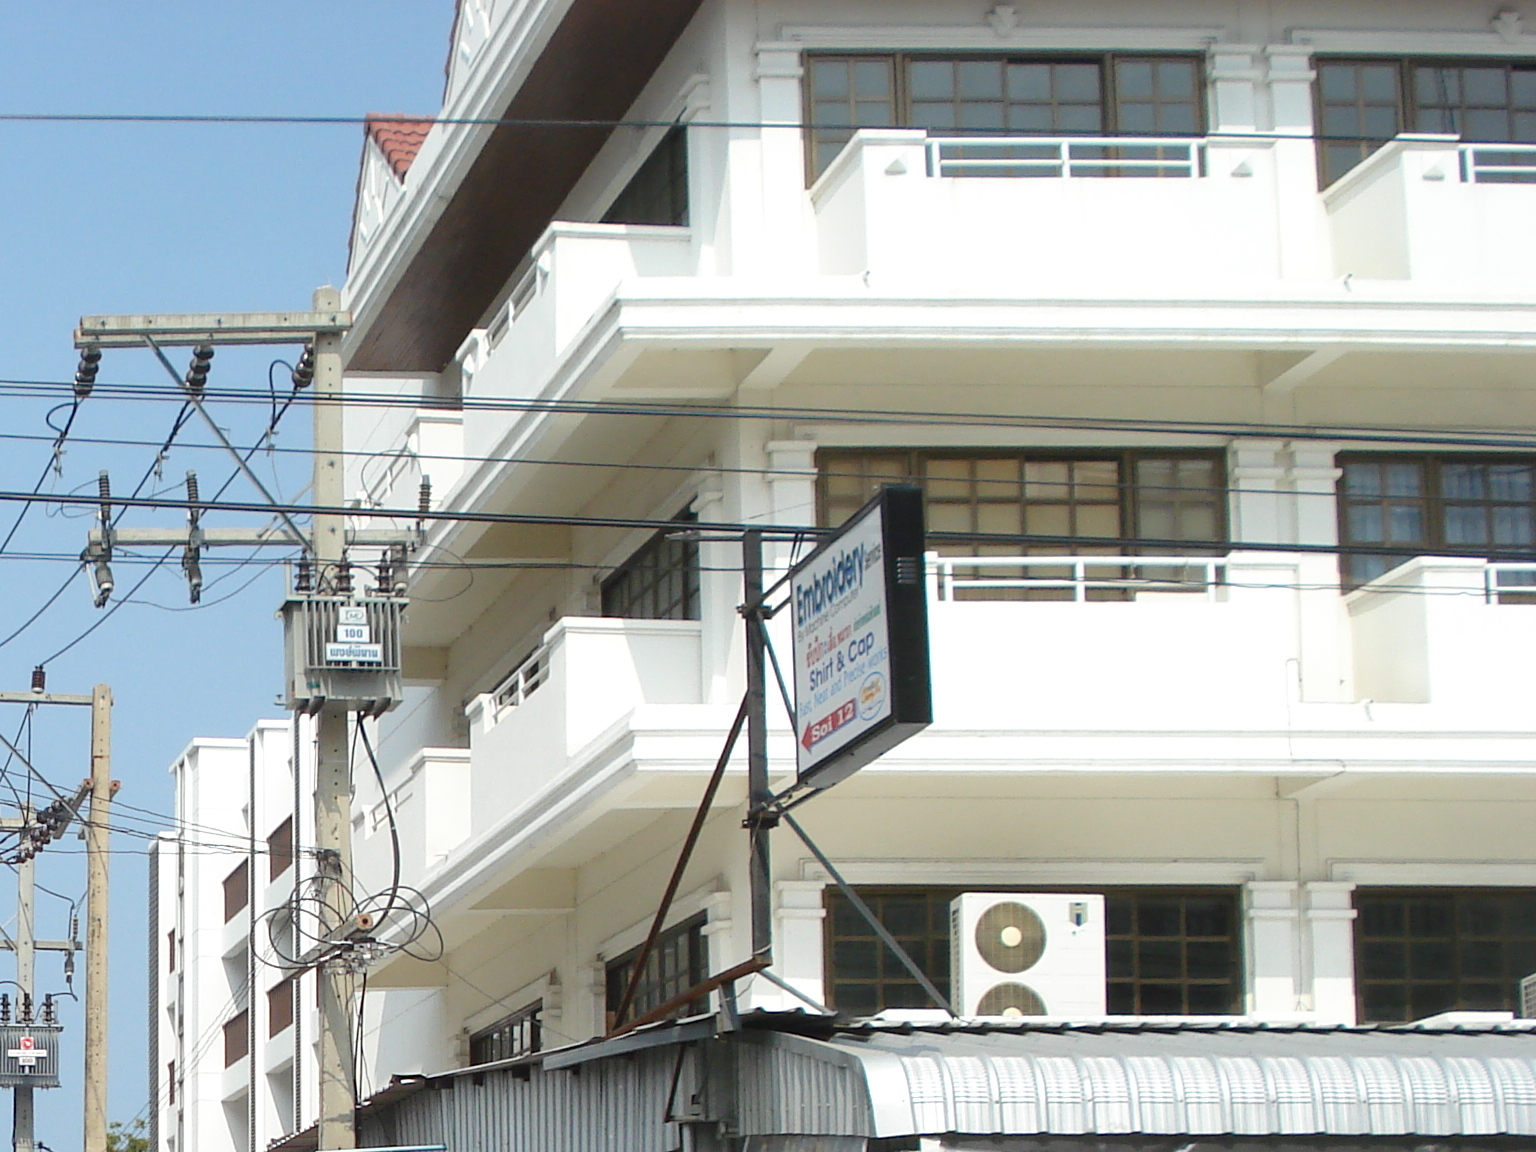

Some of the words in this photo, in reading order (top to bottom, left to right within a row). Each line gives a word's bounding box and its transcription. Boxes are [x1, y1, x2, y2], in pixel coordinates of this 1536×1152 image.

[797, 543, 864, 627] Embroidery
[344, 628, 363, 638] 100
[809, 657, 833, 691] Shirt
[837, 651, 845, 672] &
[848, 632, 875, 662] Cap
[811, 716, 832, 742] Soi
[837, 701, 854, 728] 12
